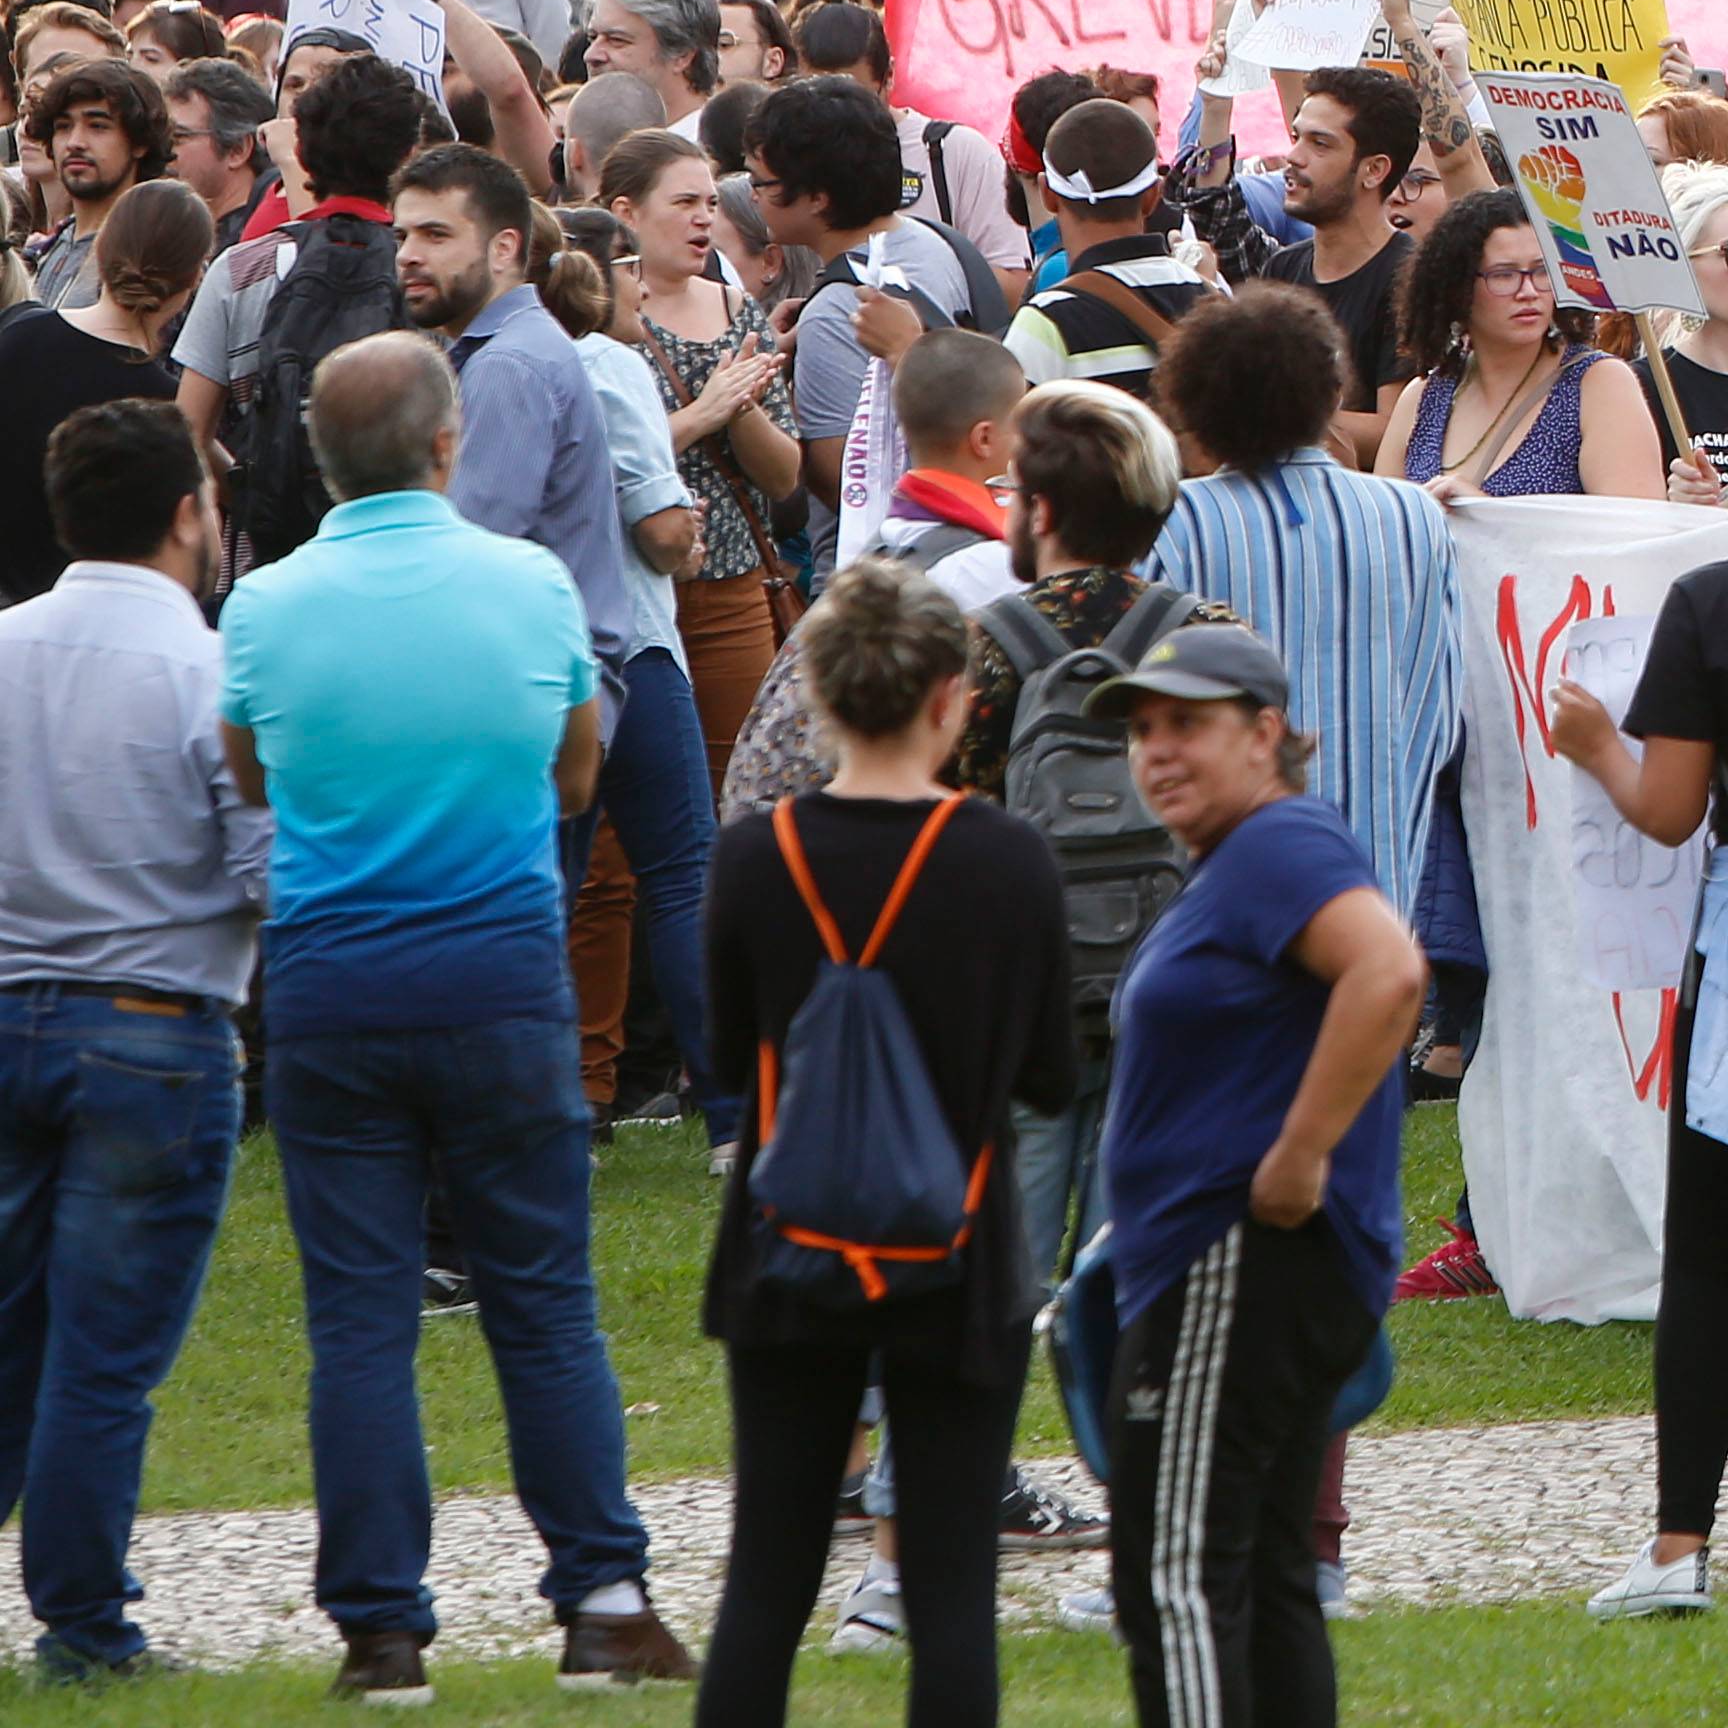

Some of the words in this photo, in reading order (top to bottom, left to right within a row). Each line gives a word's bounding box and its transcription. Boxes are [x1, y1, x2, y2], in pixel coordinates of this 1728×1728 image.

[1487, 84, 1628, 116] DEMOCRACIA
[1535, 114, 1600, 141] SIM
[1593, 209, 1673, 232] DITADURA
[1605, 227, 1680, 263] NÃO
